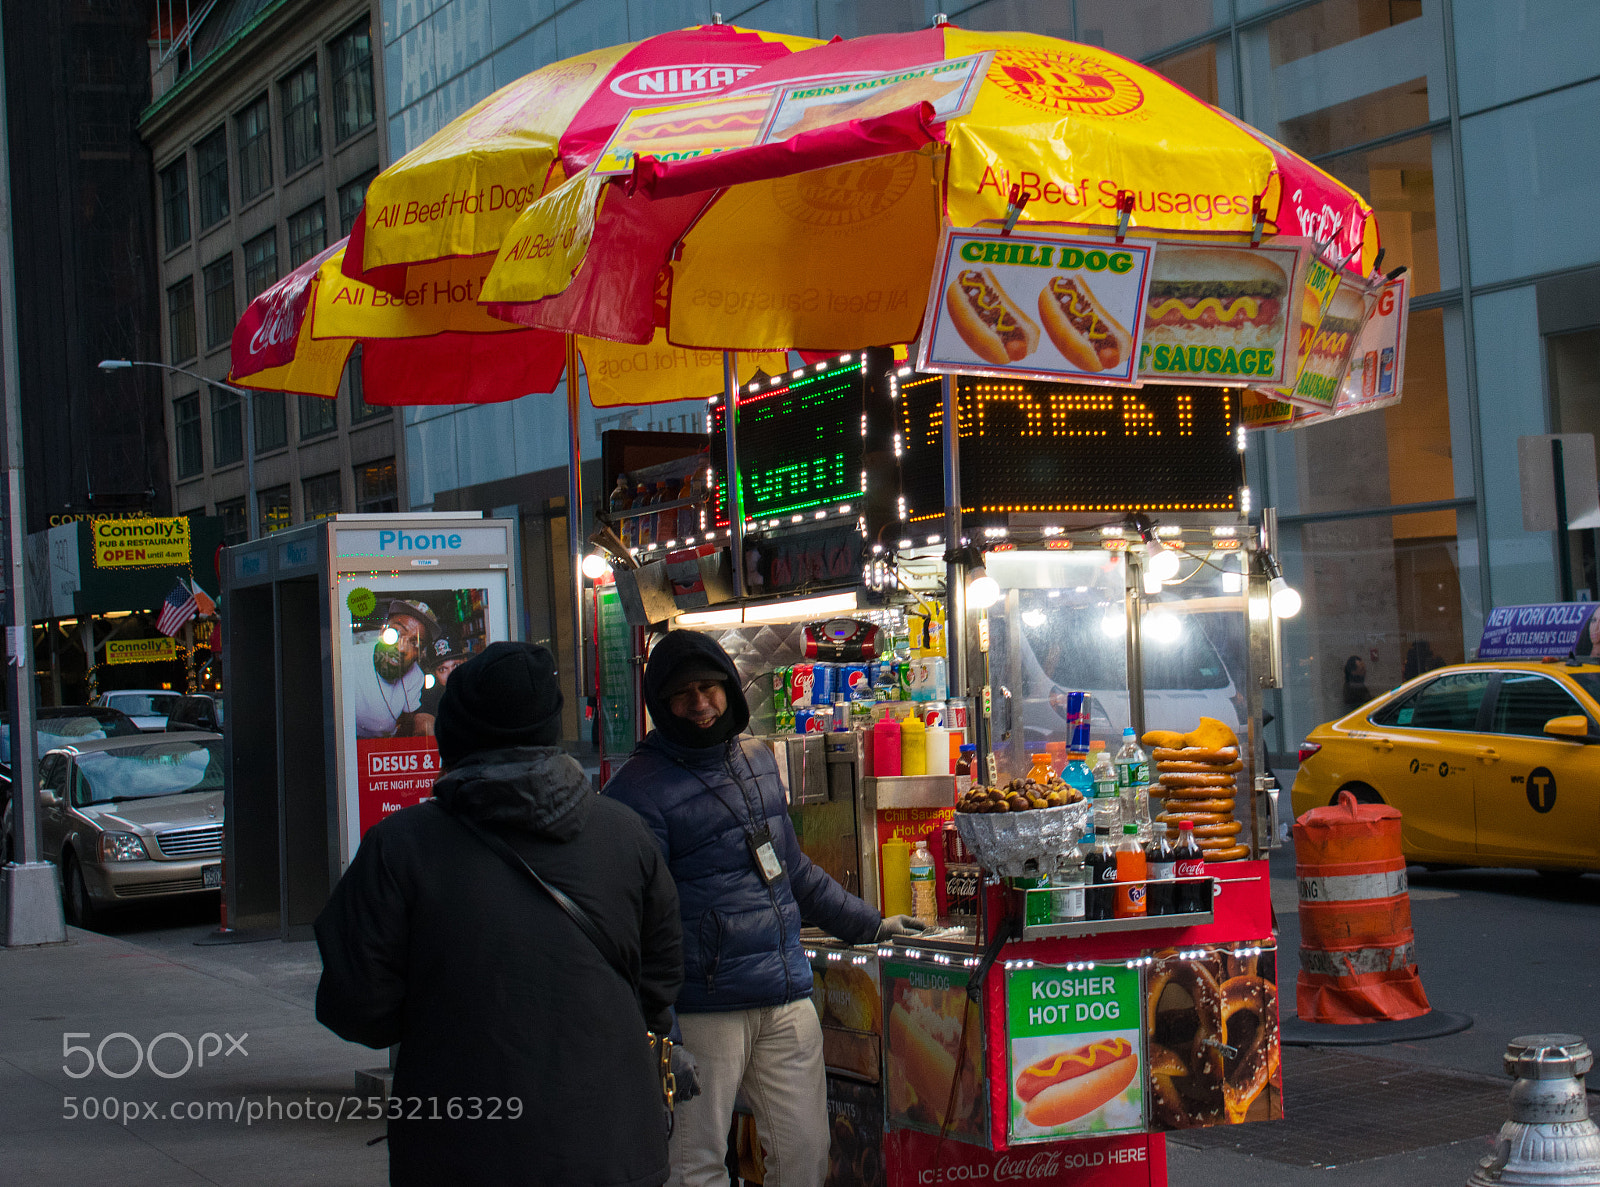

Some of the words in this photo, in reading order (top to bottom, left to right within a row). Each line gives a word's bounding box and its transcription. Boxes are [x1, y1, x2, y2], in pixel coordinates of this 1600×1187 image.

[853, 69, 928, 92] POTATO
[789, 84, 852, 100] KNISH
[976, 166, 1010, 198] All
[1020, 171, 1090, 207] Beef
[372, 205, 402, 230] All
[403, 198, 448, 226] Beef
[449, 189, 486, 217] Hot
[489, 182, 535, 214] Dogs
[504, 235, 532, 262] All
[526, 233, 559, 260] Bee
[960, 241, 1056, 268] CHILI
[1058, 250, 1135, 275] DOG
[332, 286, 366, 306] All
[433, 279, 474, 302] Hot
[1152, 344, 1276, 377] SAUSAGE
[1298, 370, 1339, 402] SAUSAGE
[98, 520, 184, 538] Connolly's
[99, 540, 118, 548] PUB
[119, 539, 125, 547] &
[127, 537, 185, 547] RESTAURANT
[379, 530, 462, 551] Phone
[103, 549, 146, 562] OPEN
[147, 551, 164, 560] until
[165, 551, 183, 559] 4am
[1487, 608, 1517, 627] NEW
[1516, 607, 1548, 626] YORK
[1546, 605, 1586, 625] DOLLS
[109, 638, 172, 653] Connolly's
[1505, 631, 1557, 645] GENTLEMEN'S
[1557, 630, 1578, 644] CLUB
[372, 754, 418, 773] DESUS
[423, 754, 434, 769] &
[369, 780, 388, 792] LATE
[390, 779, 414, 791] NIGHT
[415, 778, 435, 789] JUST
[1533, 776, 1550, 808] T
[884, 809, 908, 822] Chili
[896, 825, 915, 836] Hot
[918, 822, 940, 835] Kni
[909, 971, 930, 988] CHILI
[931, 974, 950, 991] DOG
[1031, 976, 1117, 1001] KOSHER
[1028, 1003, 1071, 1027] HOT
[1075, 1000, 1121, 1024] DOG
[826, 1099, 856, 1118] STNUTS
[918, 1169, 943, 1185] ICE
[947, 1163, 990, 1182] COLD
[1064, 1151, 1104, 1169] SOLD
[1108, 1147, 1147, 1165] HERE
